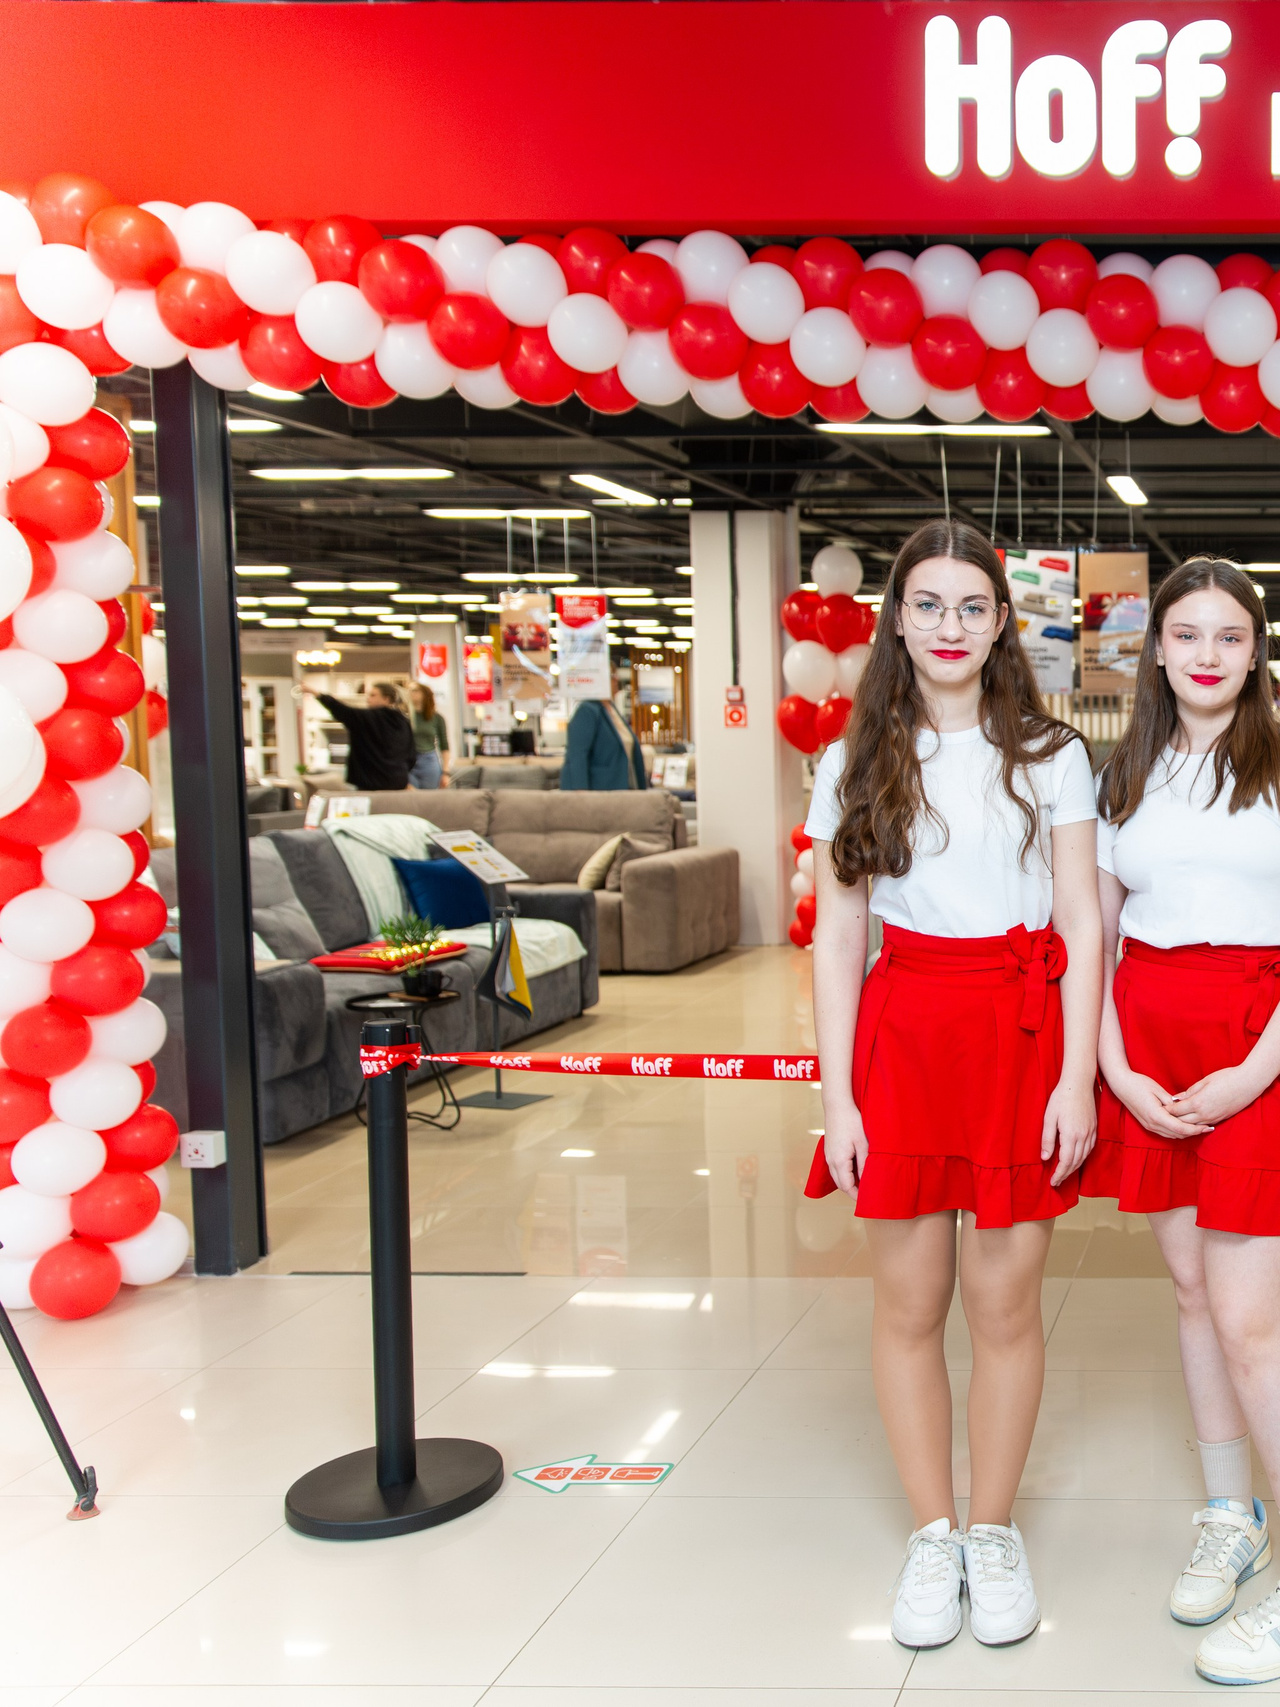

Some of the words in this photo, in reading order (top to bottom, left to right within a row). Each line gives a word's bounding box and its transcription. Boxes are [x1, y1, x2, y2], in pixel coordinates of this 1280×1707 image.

[632, 1057, 673, 1075] Hoff
[703, 1058, 744, 1077] Hoff
[774, 1059, 815, 1079] Hoff
